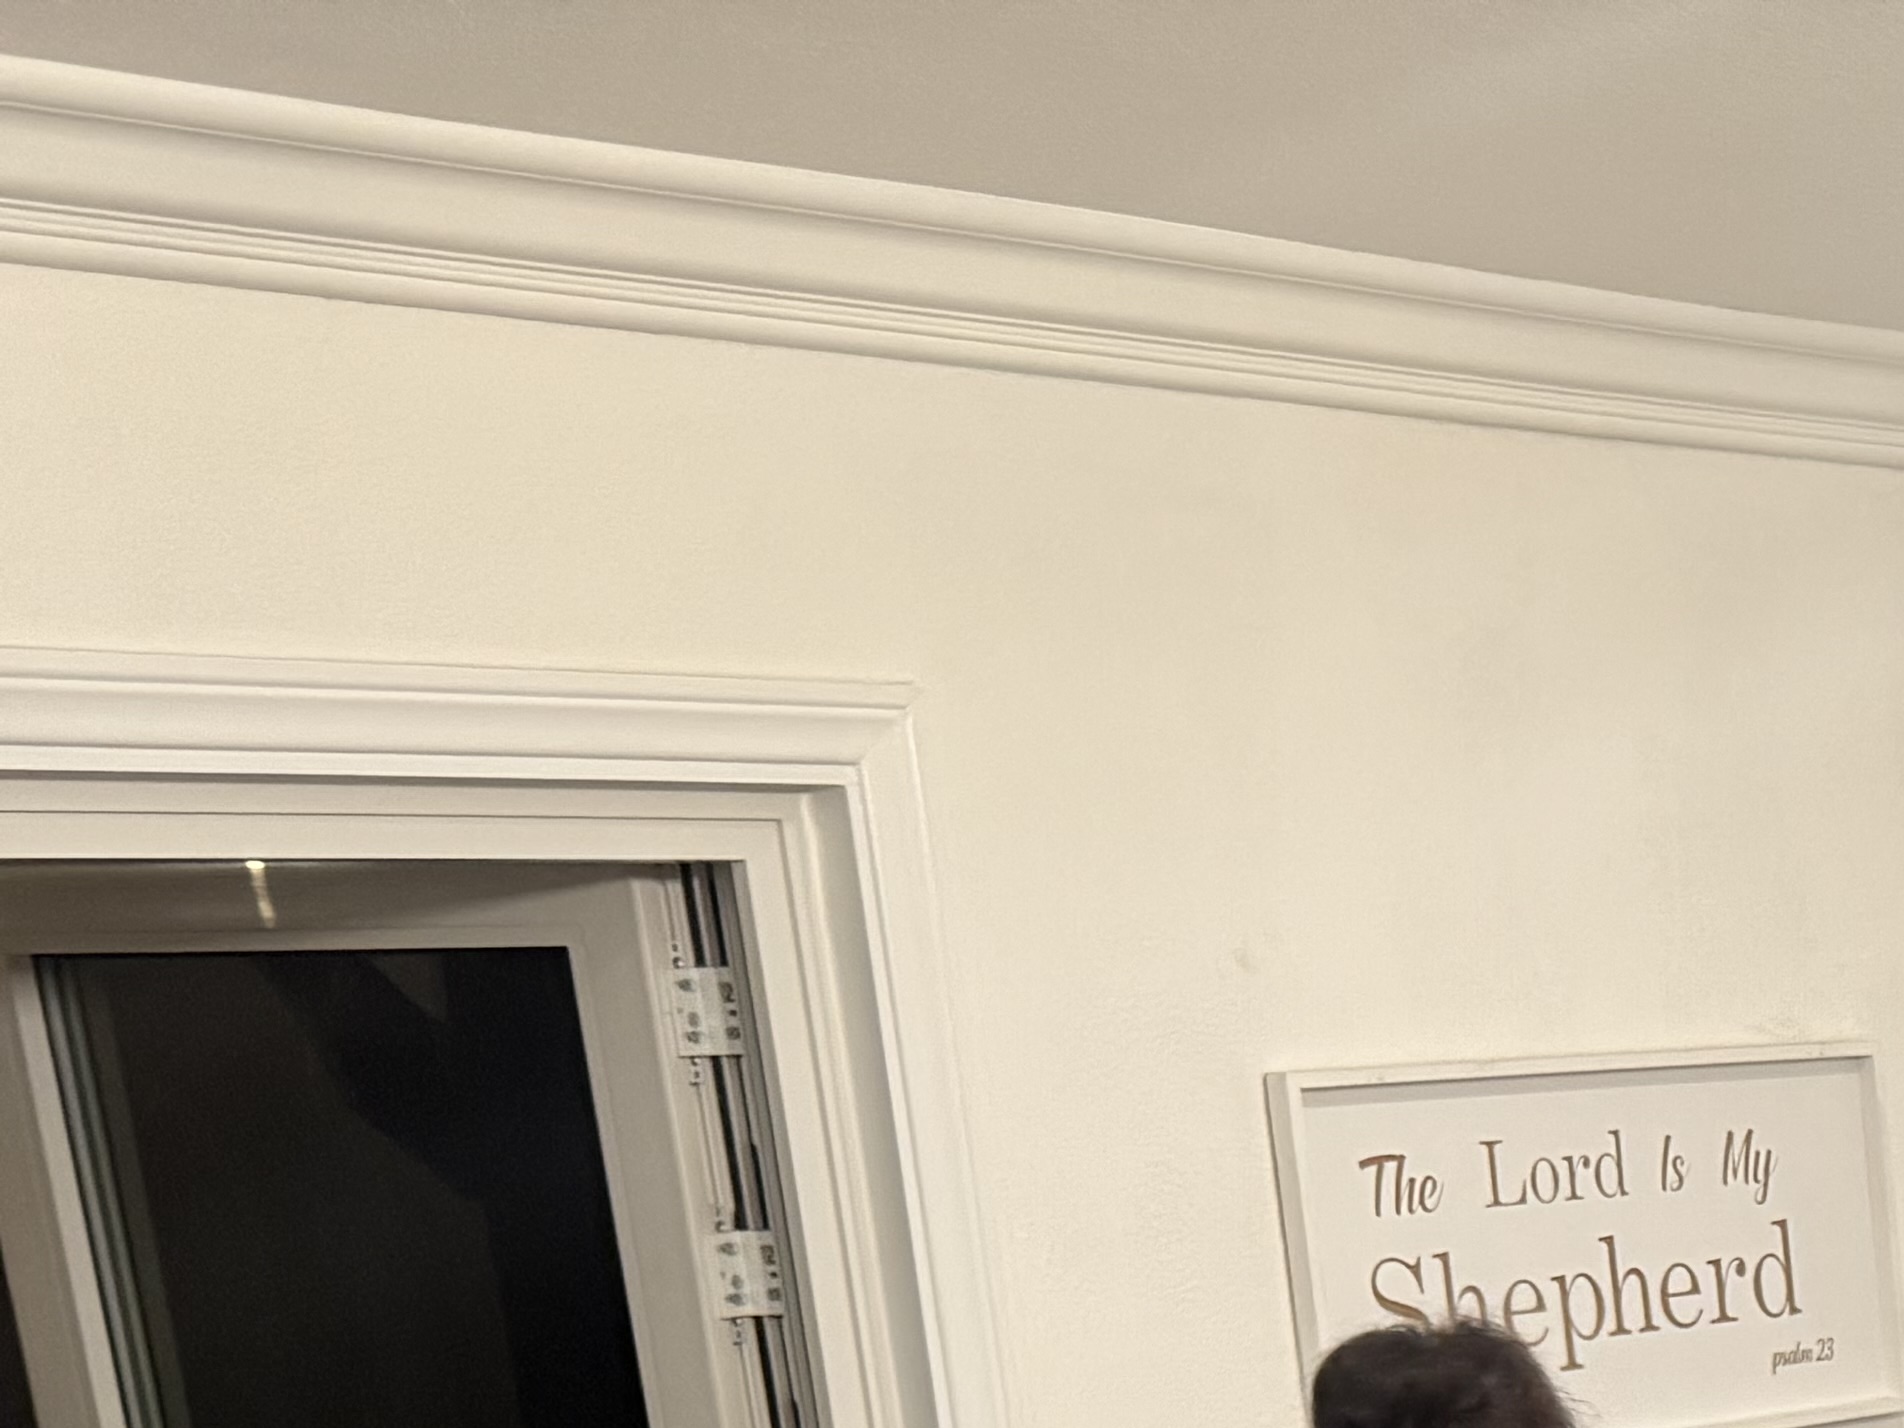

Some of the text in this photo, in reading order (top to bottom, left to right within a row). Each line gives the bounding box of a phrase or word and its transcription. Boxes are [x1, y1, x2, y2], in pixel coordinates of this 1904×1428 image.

[1358, 1128, 1778, 1219] The Lord Is My
[1771, 1337, 1835, 1375] psalm 23
